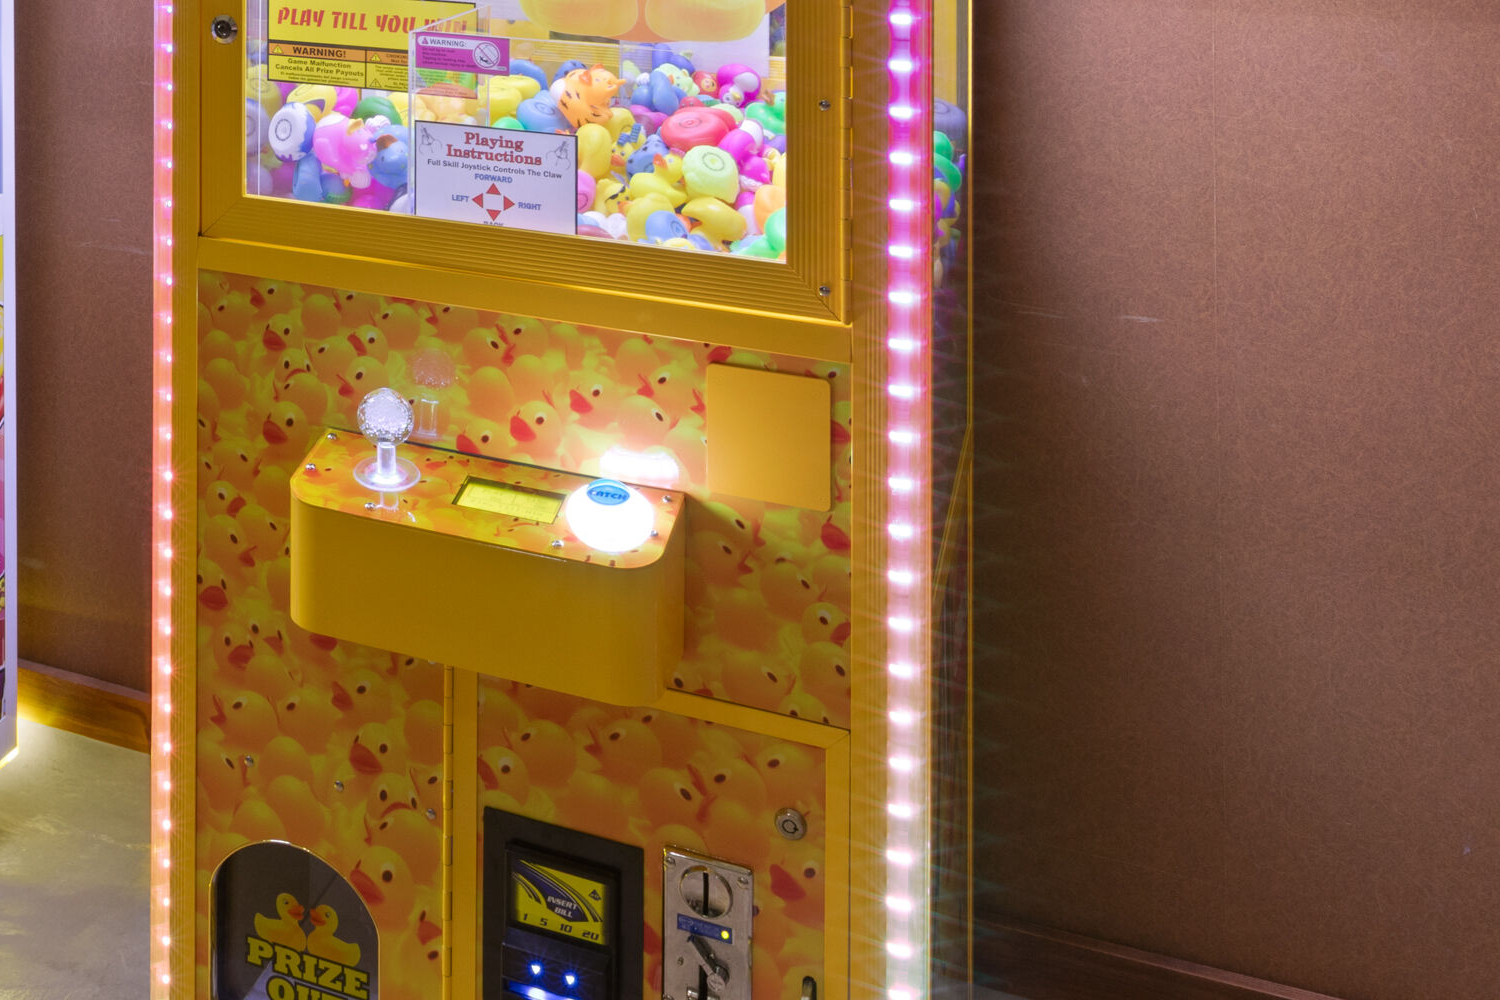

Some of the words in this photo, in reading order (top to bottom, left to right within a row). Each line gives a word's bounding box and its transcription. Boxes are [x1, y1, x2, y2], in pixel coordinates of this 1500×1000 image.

[277, 6, 324, 27] PLAY
[332, 11, 367, 30] TILL
[376, 14, 415, 34] YOU
[293, 46, 347, 58] WARNING!
[429, 38, 467, 48] WARNING:
[275, 63, 303, 71] Cancels
[336, 69, 364, 77] Payouts
[310, 60, 351, 68] Malfunction
[464, 132, 524, 152] Playing
[446, 143, 542, 166] Instructions
[427, 158, 441, 166] Full
[443, 160, 460, 168] Skill
[461, 162, 491, 172] Joystick
[493, 165, 525, 175] Controls
[527, 169, 542, 177] The
[543, 170, 562, 179] Claw
[474, 173, 513, 184] FORWARD
[452, 193, 469, 202] LEFT
[518, 201, 542, 211] RIGHT
[547, 895, 578, 910] INSERT
[554, 906, 573, 918] BILL
[523, 913, 528, 921] 1
[540, 918, 548, 927] 5
[560, 923, 573, 933] 10
[582, 931, 599, 941] 20
[246, 936, 370, 1000] PRIZE
[267, 976, 349, 1000] OU
